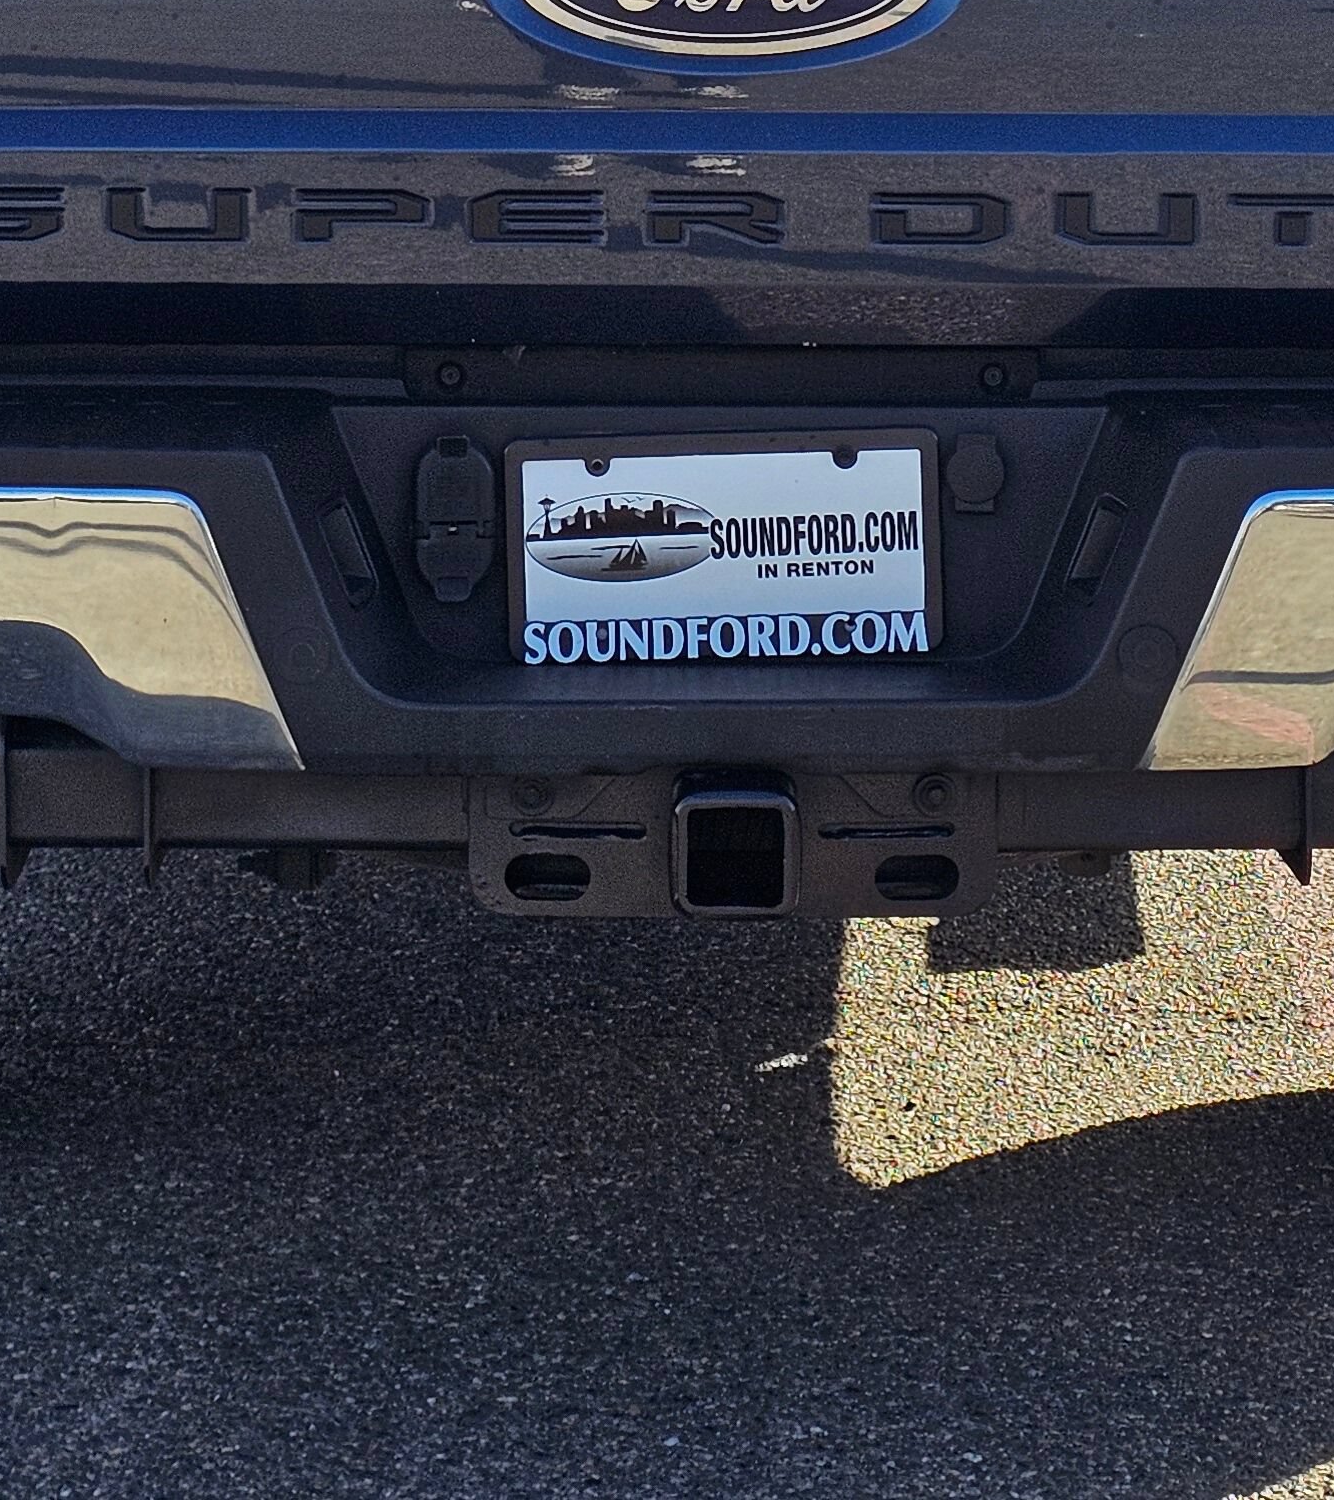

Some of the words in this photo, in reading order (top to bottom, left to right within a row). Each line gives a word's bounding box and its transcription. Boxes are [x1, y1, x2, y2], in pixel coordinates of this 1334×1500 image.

[709, 510, 920, 560] SOUNDFORD.COM
[757, 563, 778, 579] IN
[786, 560, 874, 578] RENTON
[523, 611, 930, 666] SOUNDFORD.COM
